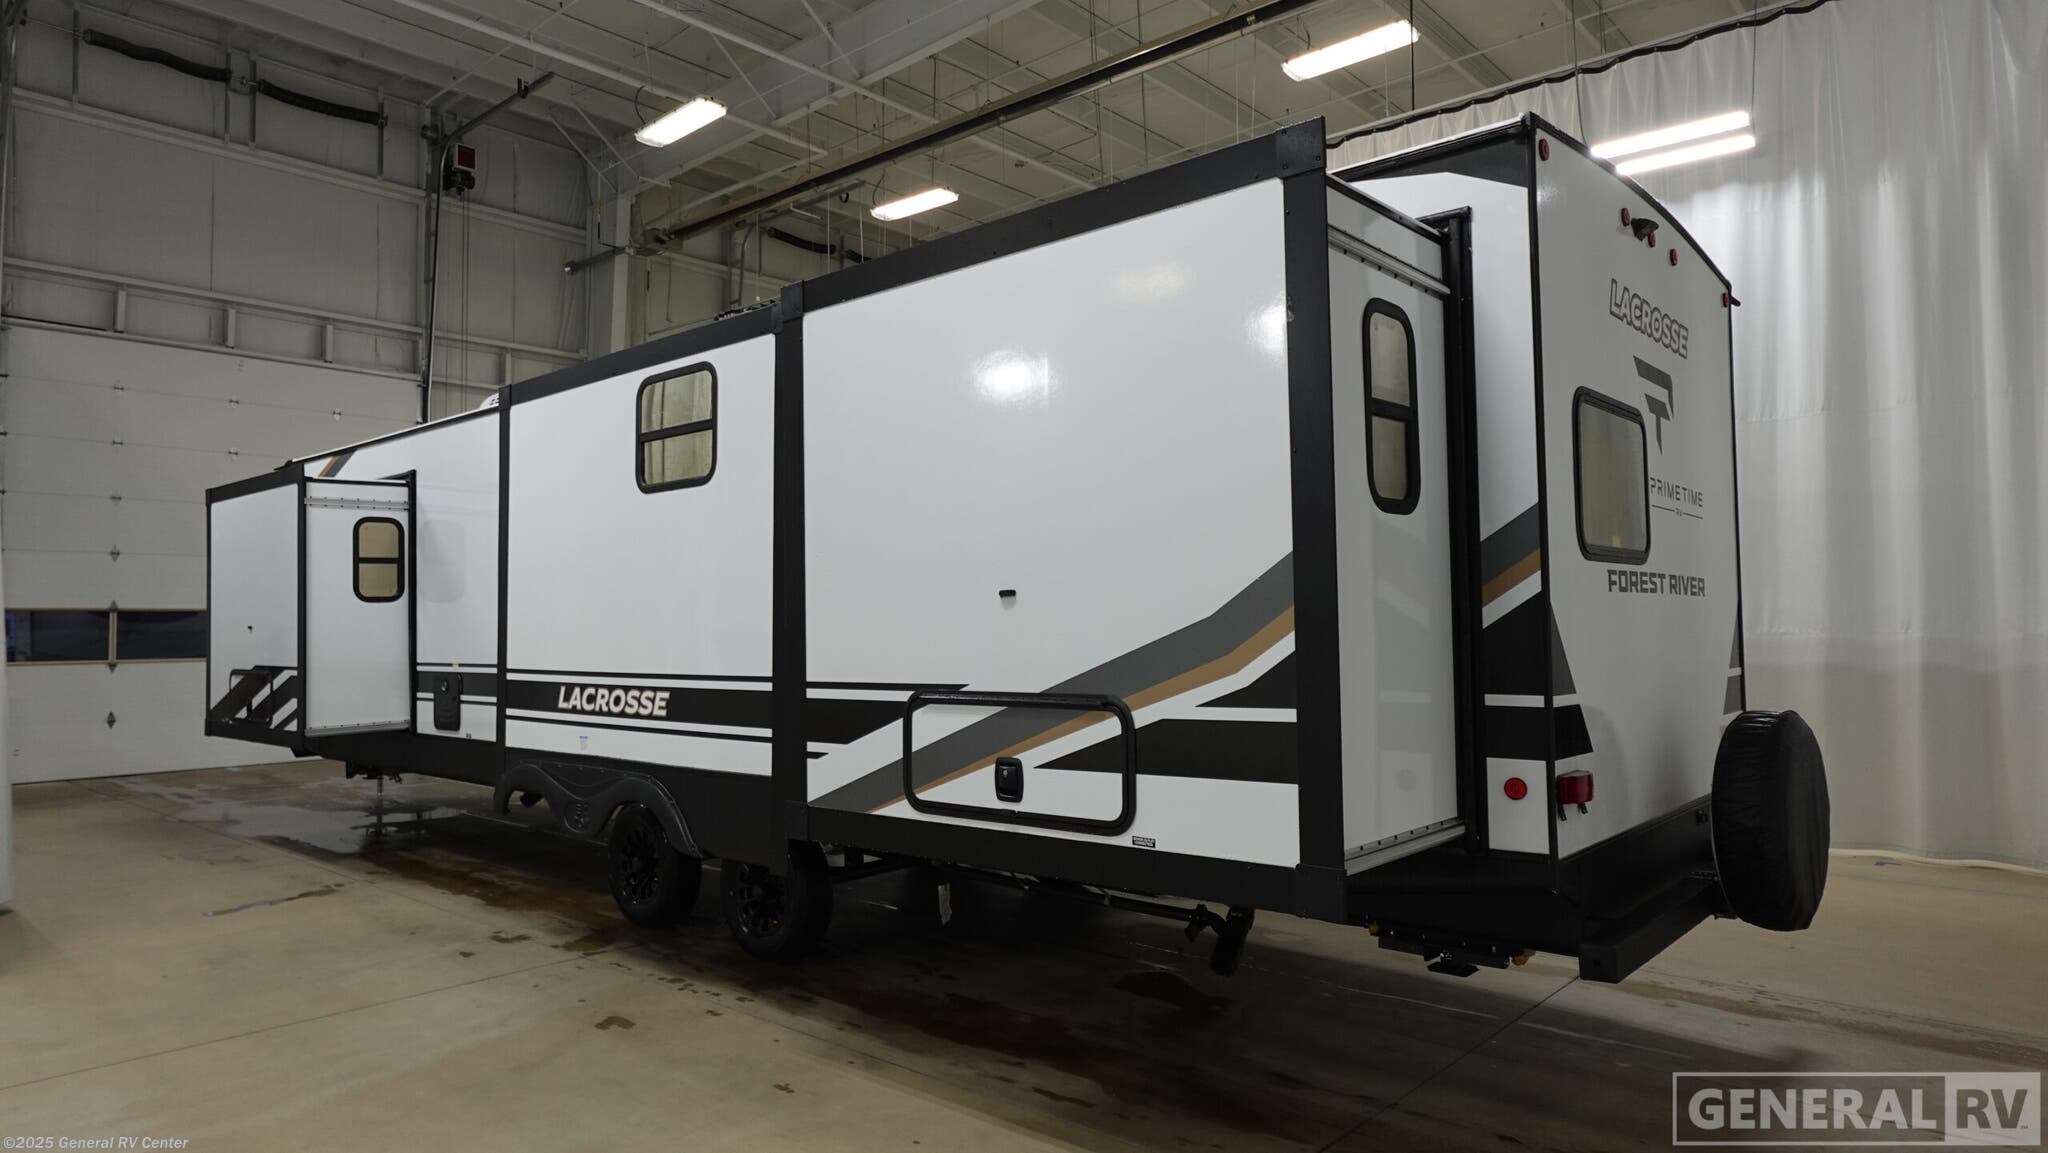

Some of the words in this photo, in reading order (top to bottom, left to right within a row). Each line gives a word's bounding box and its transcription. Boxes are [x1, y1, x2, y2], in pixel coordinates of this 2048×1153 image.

[1609, 277, 1689, 359] LACROSSE
[1607, 569, 1666, 594] FOREST
[1668, 574, 1706, 597] RIVER
[557, 685, 671, 717] LACROSSE
